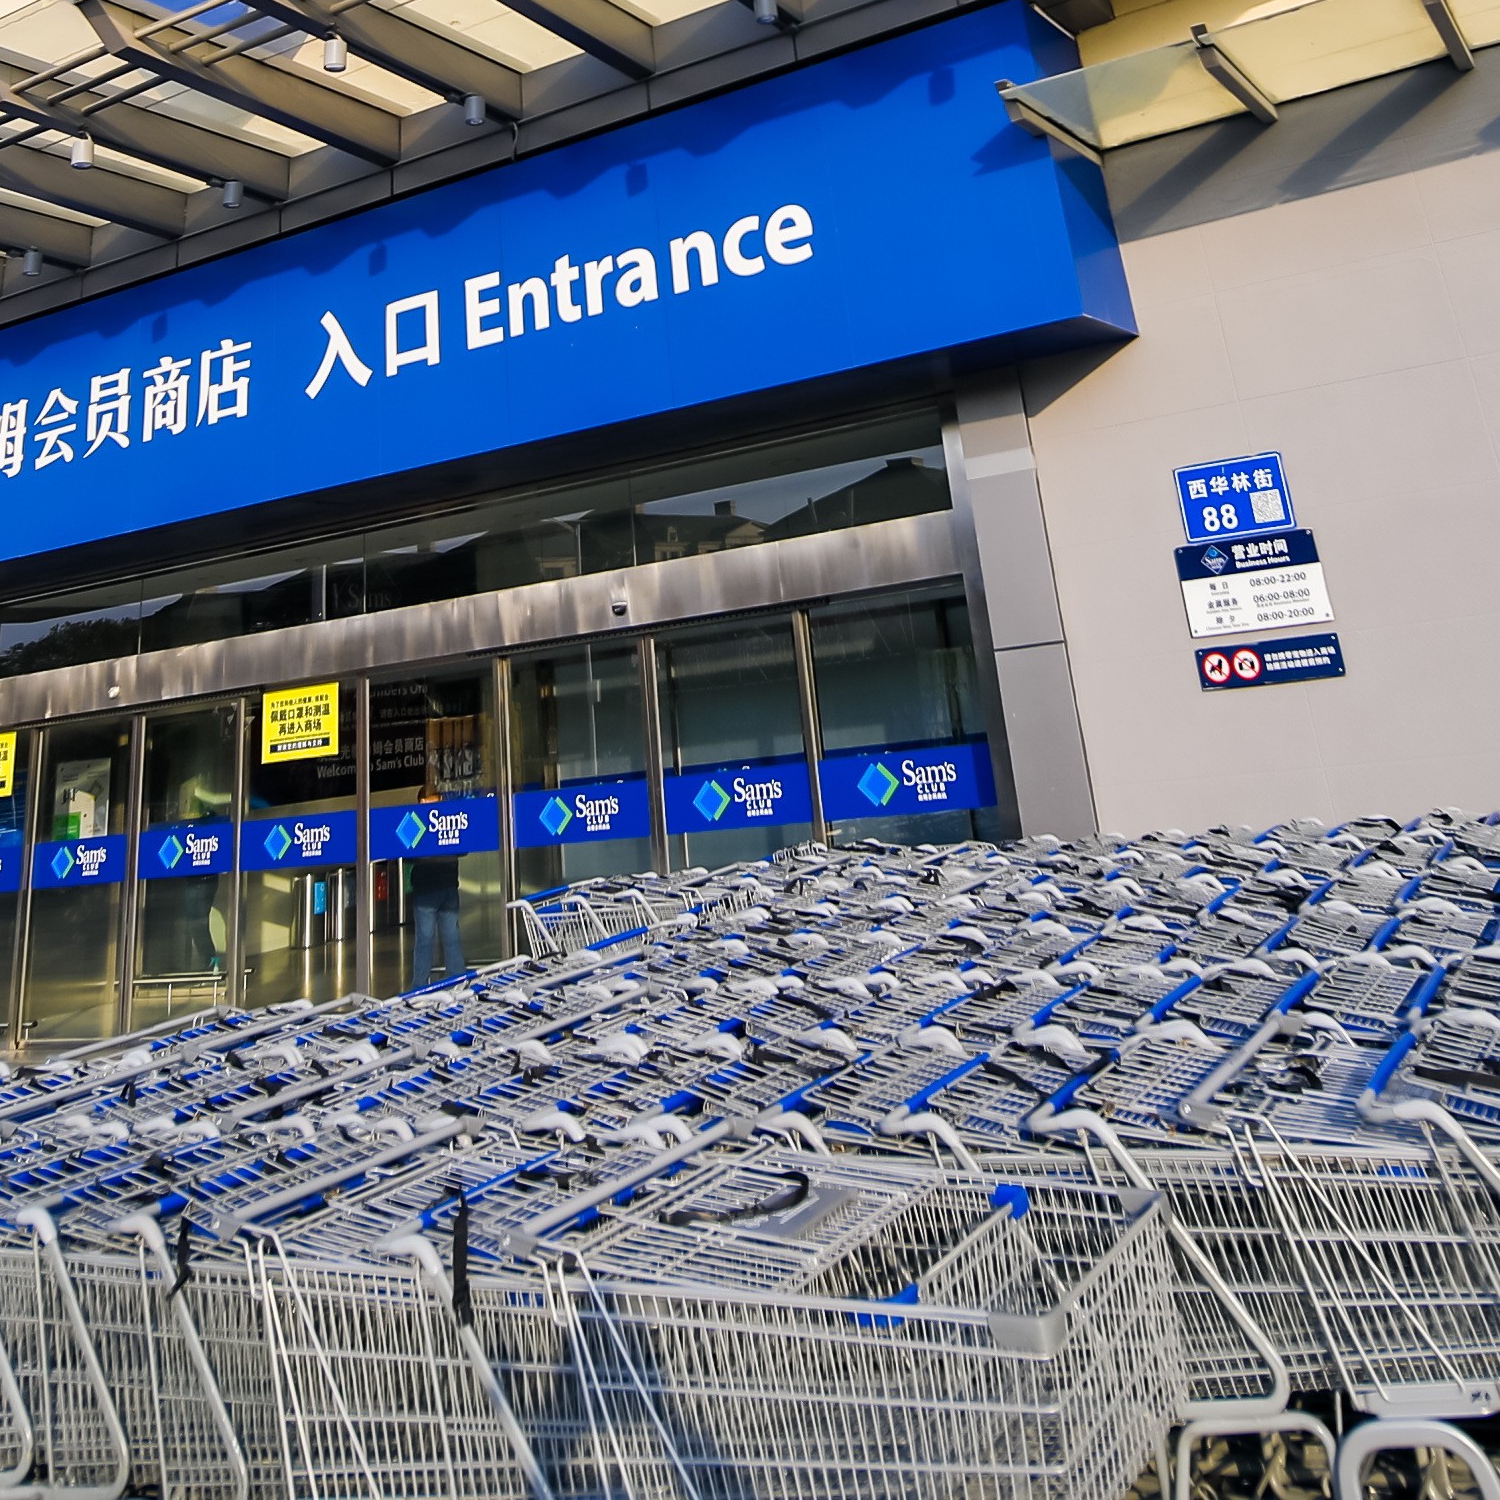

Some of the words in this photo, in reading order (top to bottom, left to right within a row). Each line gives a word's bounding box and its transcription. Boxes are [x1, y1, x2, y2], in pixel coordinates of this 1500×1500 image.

[305, 290, 441, 399] 入口
[464, 204, 814, 351] Entrance
[1186, 468, 1273, 500] 西华林街
[1202, 503, 1238, 532] 88
[1231, 539, 1288, 560] 营业时间
[1250, 572, 1306, 587] 08:00-22:00
[1257, 607, 1314, 621] 08:00-20:00
[278, 719, 322, 736] 再进入商场
[317, 763, 356, 779] Welcom
[376, 756, 402, 771] Sam's
[404, 754, 425, 768] Club
[902, 759, 957, 786] Sam's
[733, 777, 782, 803] Sam's
[917, 782, 946, 794] CLUB
[575, 794, 619, 818] Sam's
[746, 799, 772, 810] CLUB
[428, 809, 468, 832] Sam's
[185, 833, 219, 854] Sam's
[294, 822, 330, 844] Sam's
